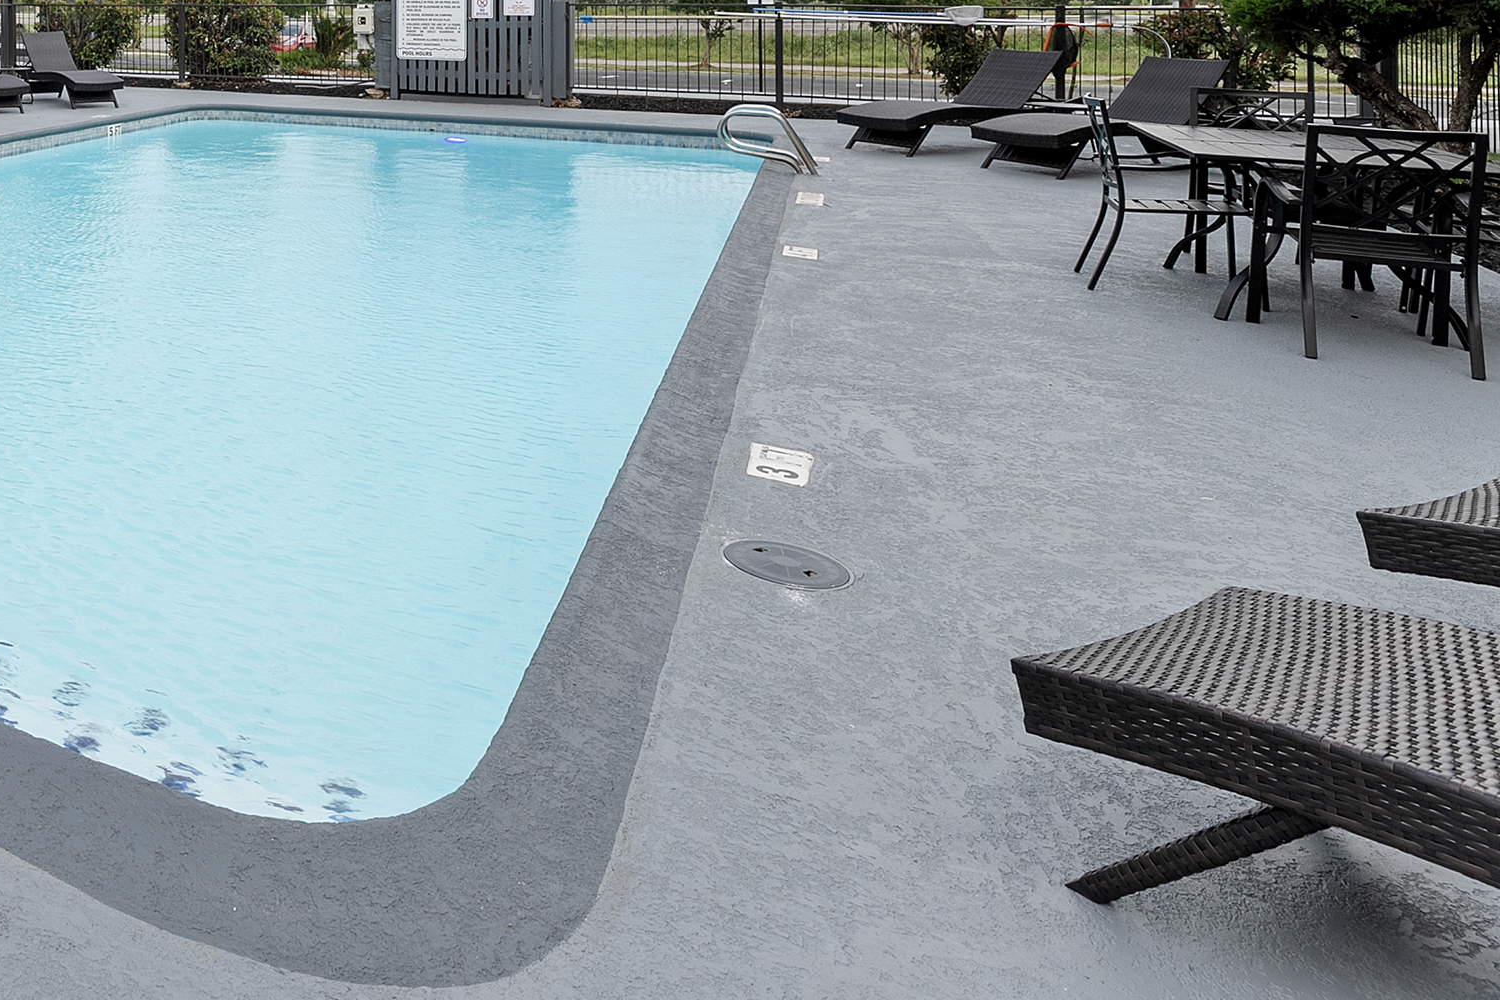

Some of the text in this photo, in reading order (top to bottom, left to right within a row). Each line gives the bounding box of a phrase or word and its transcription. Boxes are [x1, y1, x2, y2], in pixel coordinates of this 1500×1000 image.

[109, 126, 121, 136] 5 FT
[756, 465, 799, 479] 3
